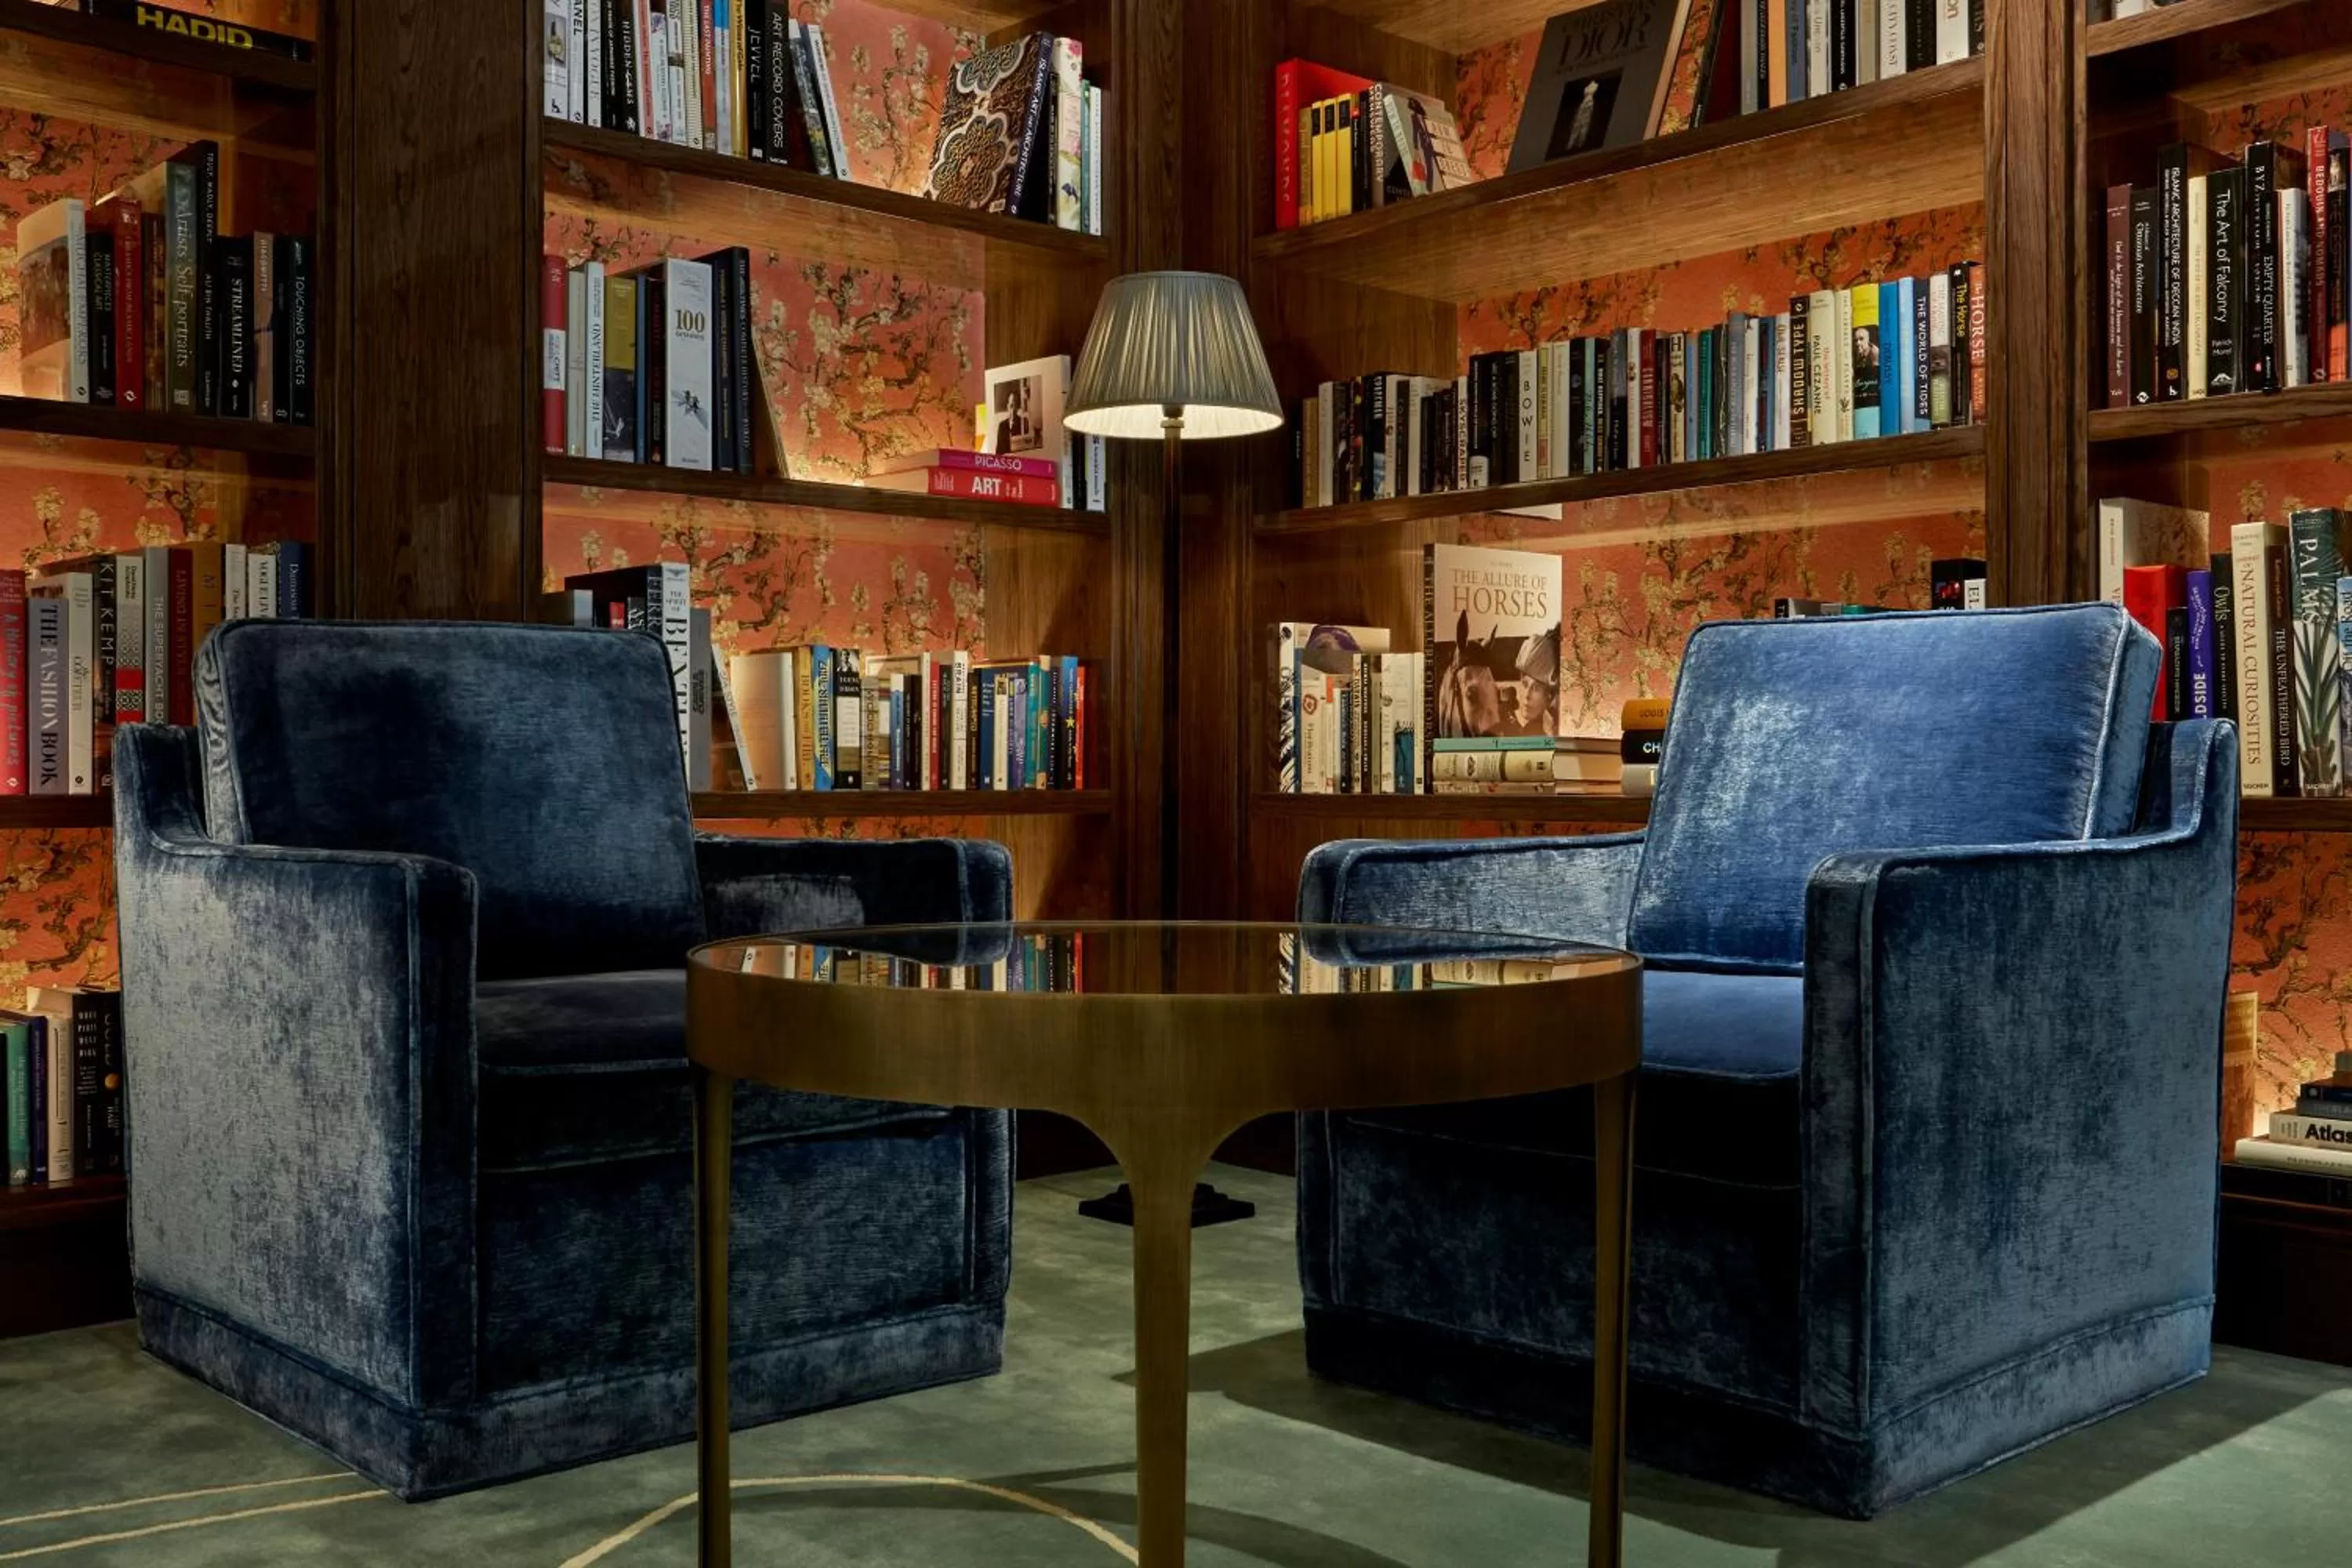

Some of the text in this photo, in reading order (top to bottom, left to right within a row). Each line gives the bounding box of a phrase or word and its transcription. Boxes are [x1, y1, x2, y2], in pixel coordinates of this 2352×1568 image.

[136, 5, 252, 49] HADID
[622, 21, 632, 69] HIDDEN
[1559, 13, 1650, 67] DIOR
[747, 26, 763, 84] JEWEL
[772, 13, 783, 148] ART RECORD COVERS
[1034, 57, 1047, 93] ISLAMIC
[1029, 96, 1041, 114] ART
[1374, 83, 1384, 183] CONTEMPORARY
[1014, 129, 1033, 197] ARCHITECTURE
[2171, 166, 2180, 202] ISLAMIC
[2314, 165, 2325, 213] BEDOUIN
[2171, 203, 2180, 266] ARCHITECTURE
[2213, 189, 2231, 323] The Art of Falconry
[2136, 263, 2144, 314] Architecture
[2171, 281, 2180, 318] DECCAN
[2263, 255, 2274, 292] EMPTY
[172, 266, 195, 368] Self-portraits
[231, 277, 243, 373] STREAMLINED
[294, 275, 306, 386] TOUCHING OBJECTS
[675, 310, 705, 332] 100
[1956, 282, 1967, 338] The Horse
[1971, 295, 1985, 361] HORSE
[2171, 319, 2180, 346] INDIA
[2263, 294, 2274, 347] QUARTER
[1792, 323, 1806, 416] SHADOW TYPE
[1813, 335, 1822, 361] PAUL
[1916, 296, 1929, 416] THE WORLD OF TIDES
[971, 477, 1003, 496] ART
[975, 457, 1022, 471] PICASSO
[176, 569, 188, 615] LIVING
[647, 575, 662, 633] FERR
[1424, 576, 1435, 606] THE
[1449, 568, 1548, 591] THE ALLURE OF
[1454, 586, 1548, 619] HORSES
[2213, 586, 2230, 622] Owls
[2299, 538, 2321, 625] PALMS
[100, 561, 114, 666] KIT KEMP
[154, 596, 164, 622] THE
[154, 623, 164, 700] SUPERYACHT
[1424, 609, 1435, 666] ALLURE
[1424, 670, 1435, 690] OF
[2240, 567, 2261, 766] NATURAL CURIOSITIES
[40, 604, 59, 786] THE FASHION BOOK
[1639, 709, 1664, 718] LOUIS
[2275, 629, 2291, 766] THE UNFEATHERED BIRD
[1642, 742, 1661, 753] CH
